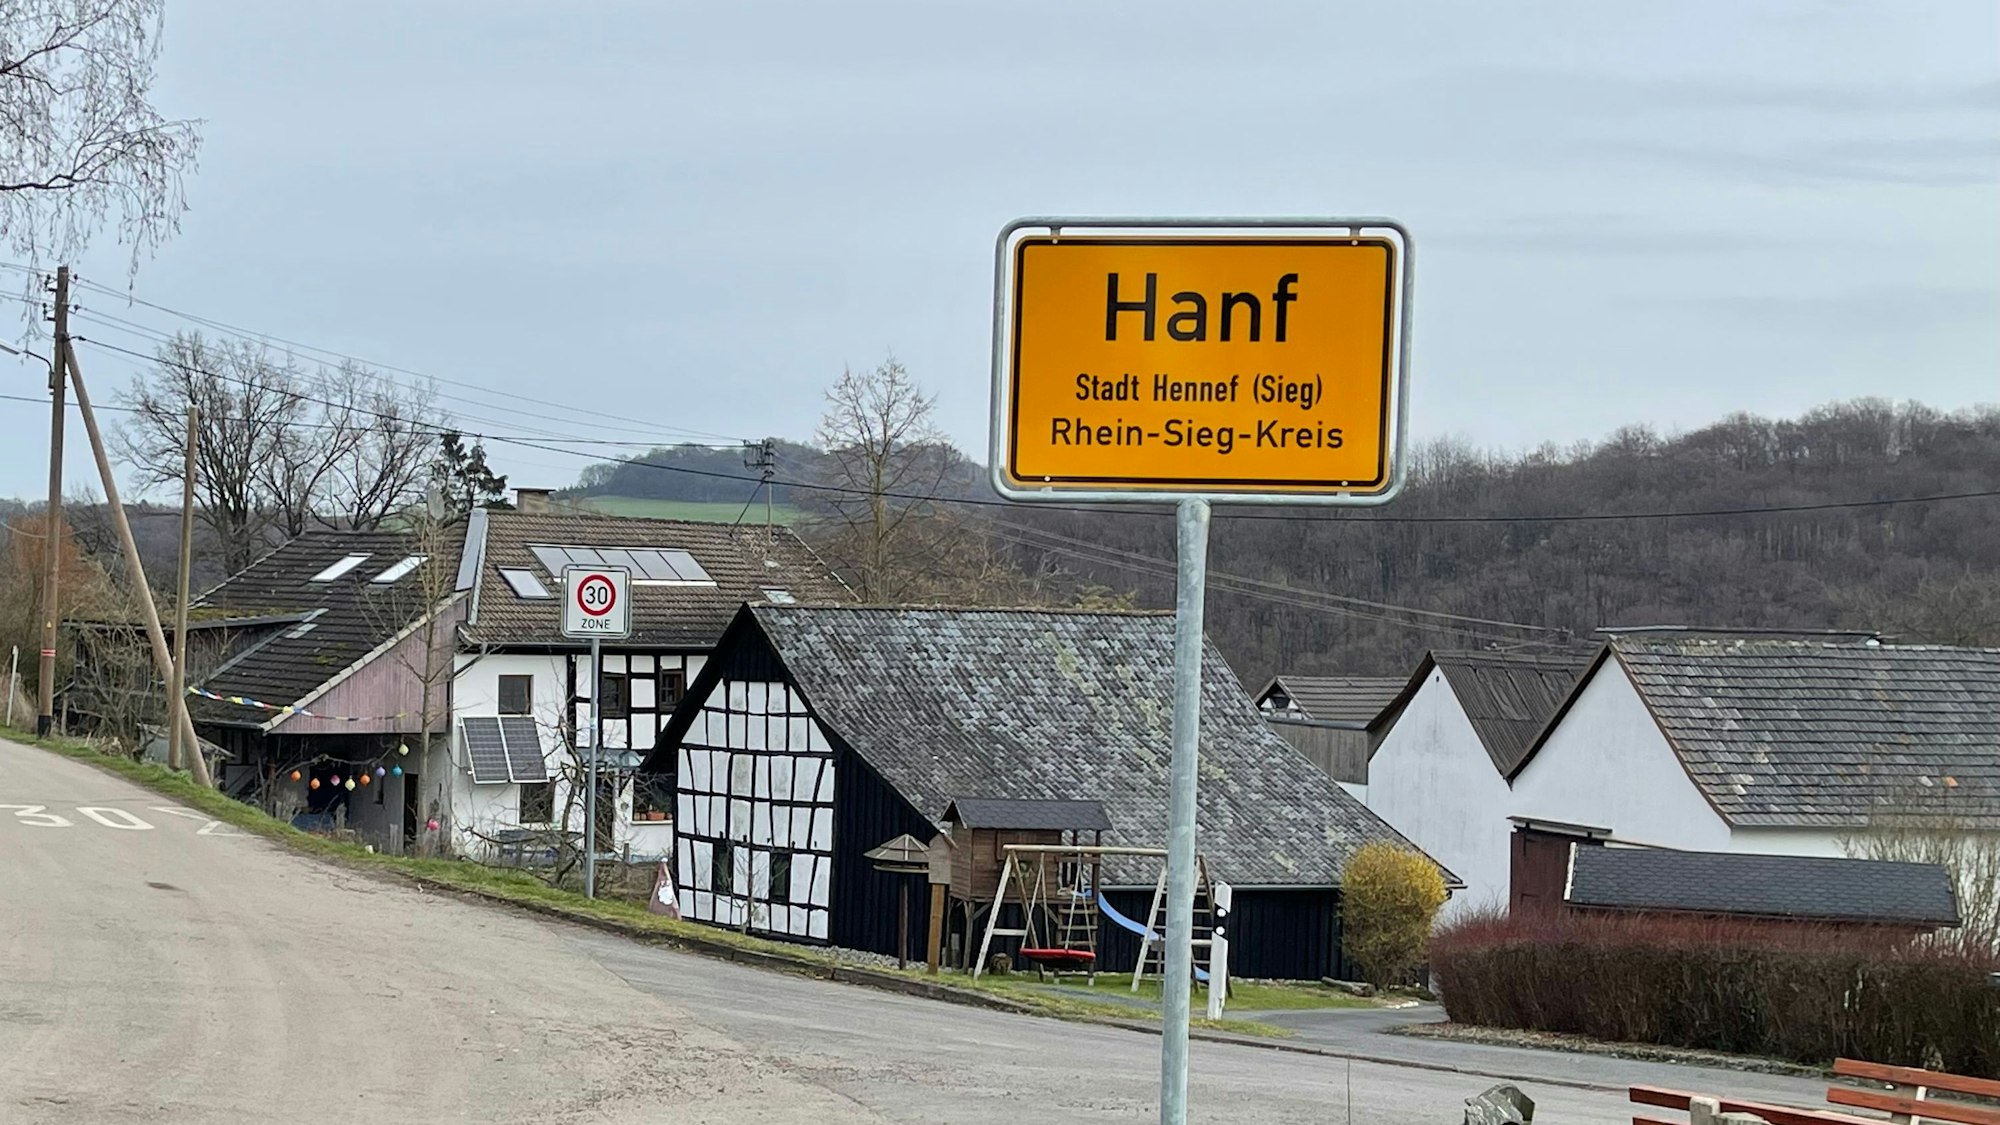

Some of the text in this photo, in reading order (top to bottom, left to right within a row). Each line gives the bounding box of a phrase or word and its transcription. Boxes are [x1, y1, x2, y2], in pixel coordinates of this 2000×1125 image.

[1105, 272, 1299, 343] Hanf
[1075, 373, 1323, 409] Stadt Hennef (Sieg)
[1051, 417, 1344, 455] Rhein-Sieg-Kreis
[585, 586, 608, 605] 30
[581, 618, 611, 629] ZONE
[0, 804, 155, 830] 30
